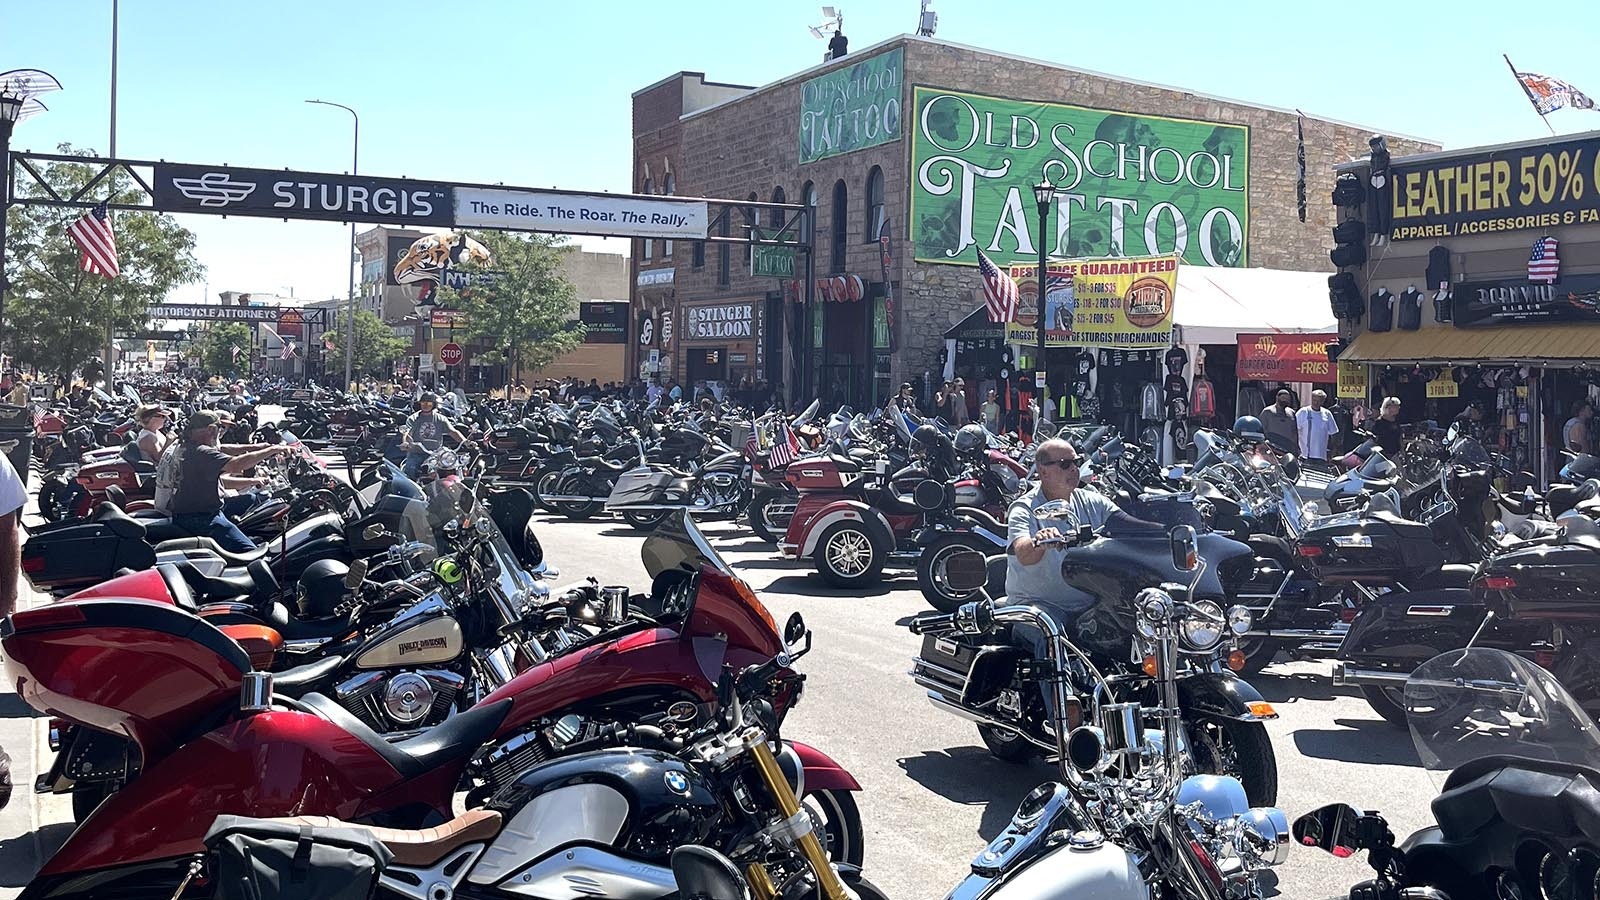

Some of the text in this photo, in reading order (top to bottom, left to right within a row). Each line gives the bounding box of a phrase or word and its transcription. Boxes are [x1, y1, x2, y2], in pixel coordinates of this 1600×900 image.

[802, 98, 900, 160] TATTOO
[919, 95, 1245, 191] OLD SCHOOL
[1392, 160, 1512, 219] LEATHER
[1519, 149, 1585, 206] 50%
[272, 181, 433, 217] STURGIS
[470, 201, 500, 215] The
[504, 203, 543, 218] Ride.
[547, 206, 576, 220] The
[580, 208, 617, 223] Roar.
[622, 211, 647, 224] The
[651, 213, 688, 228] Rally.
[917, 155, 1244, 268] TATTOO
[1392, 223, 1451, 240] APPAREL
[1460, 213, 1560, 235] ACCESSORIES
[1563, 211, 1576, 223] &
[1080, 259, 1176, 276] GUARANTEED
[1094, 282, 1104, 293] FOR
[1099, 298, 1109, 309] FOR
[217, 308, 277, 319] ATTORNEYS
[698, 305, 753, 321] STINGER
[1093, 314, 1104, 324] FOR
[698, 321, 753, 337] SALOON
[1081, 331, 1113, 342] STURGIS
[1114, 332, 1170, 343] MERCHANDISE
[441, 349, 462, 359] STOP
[399, 636, 448, 656] HARLEY-DAVIDSON
